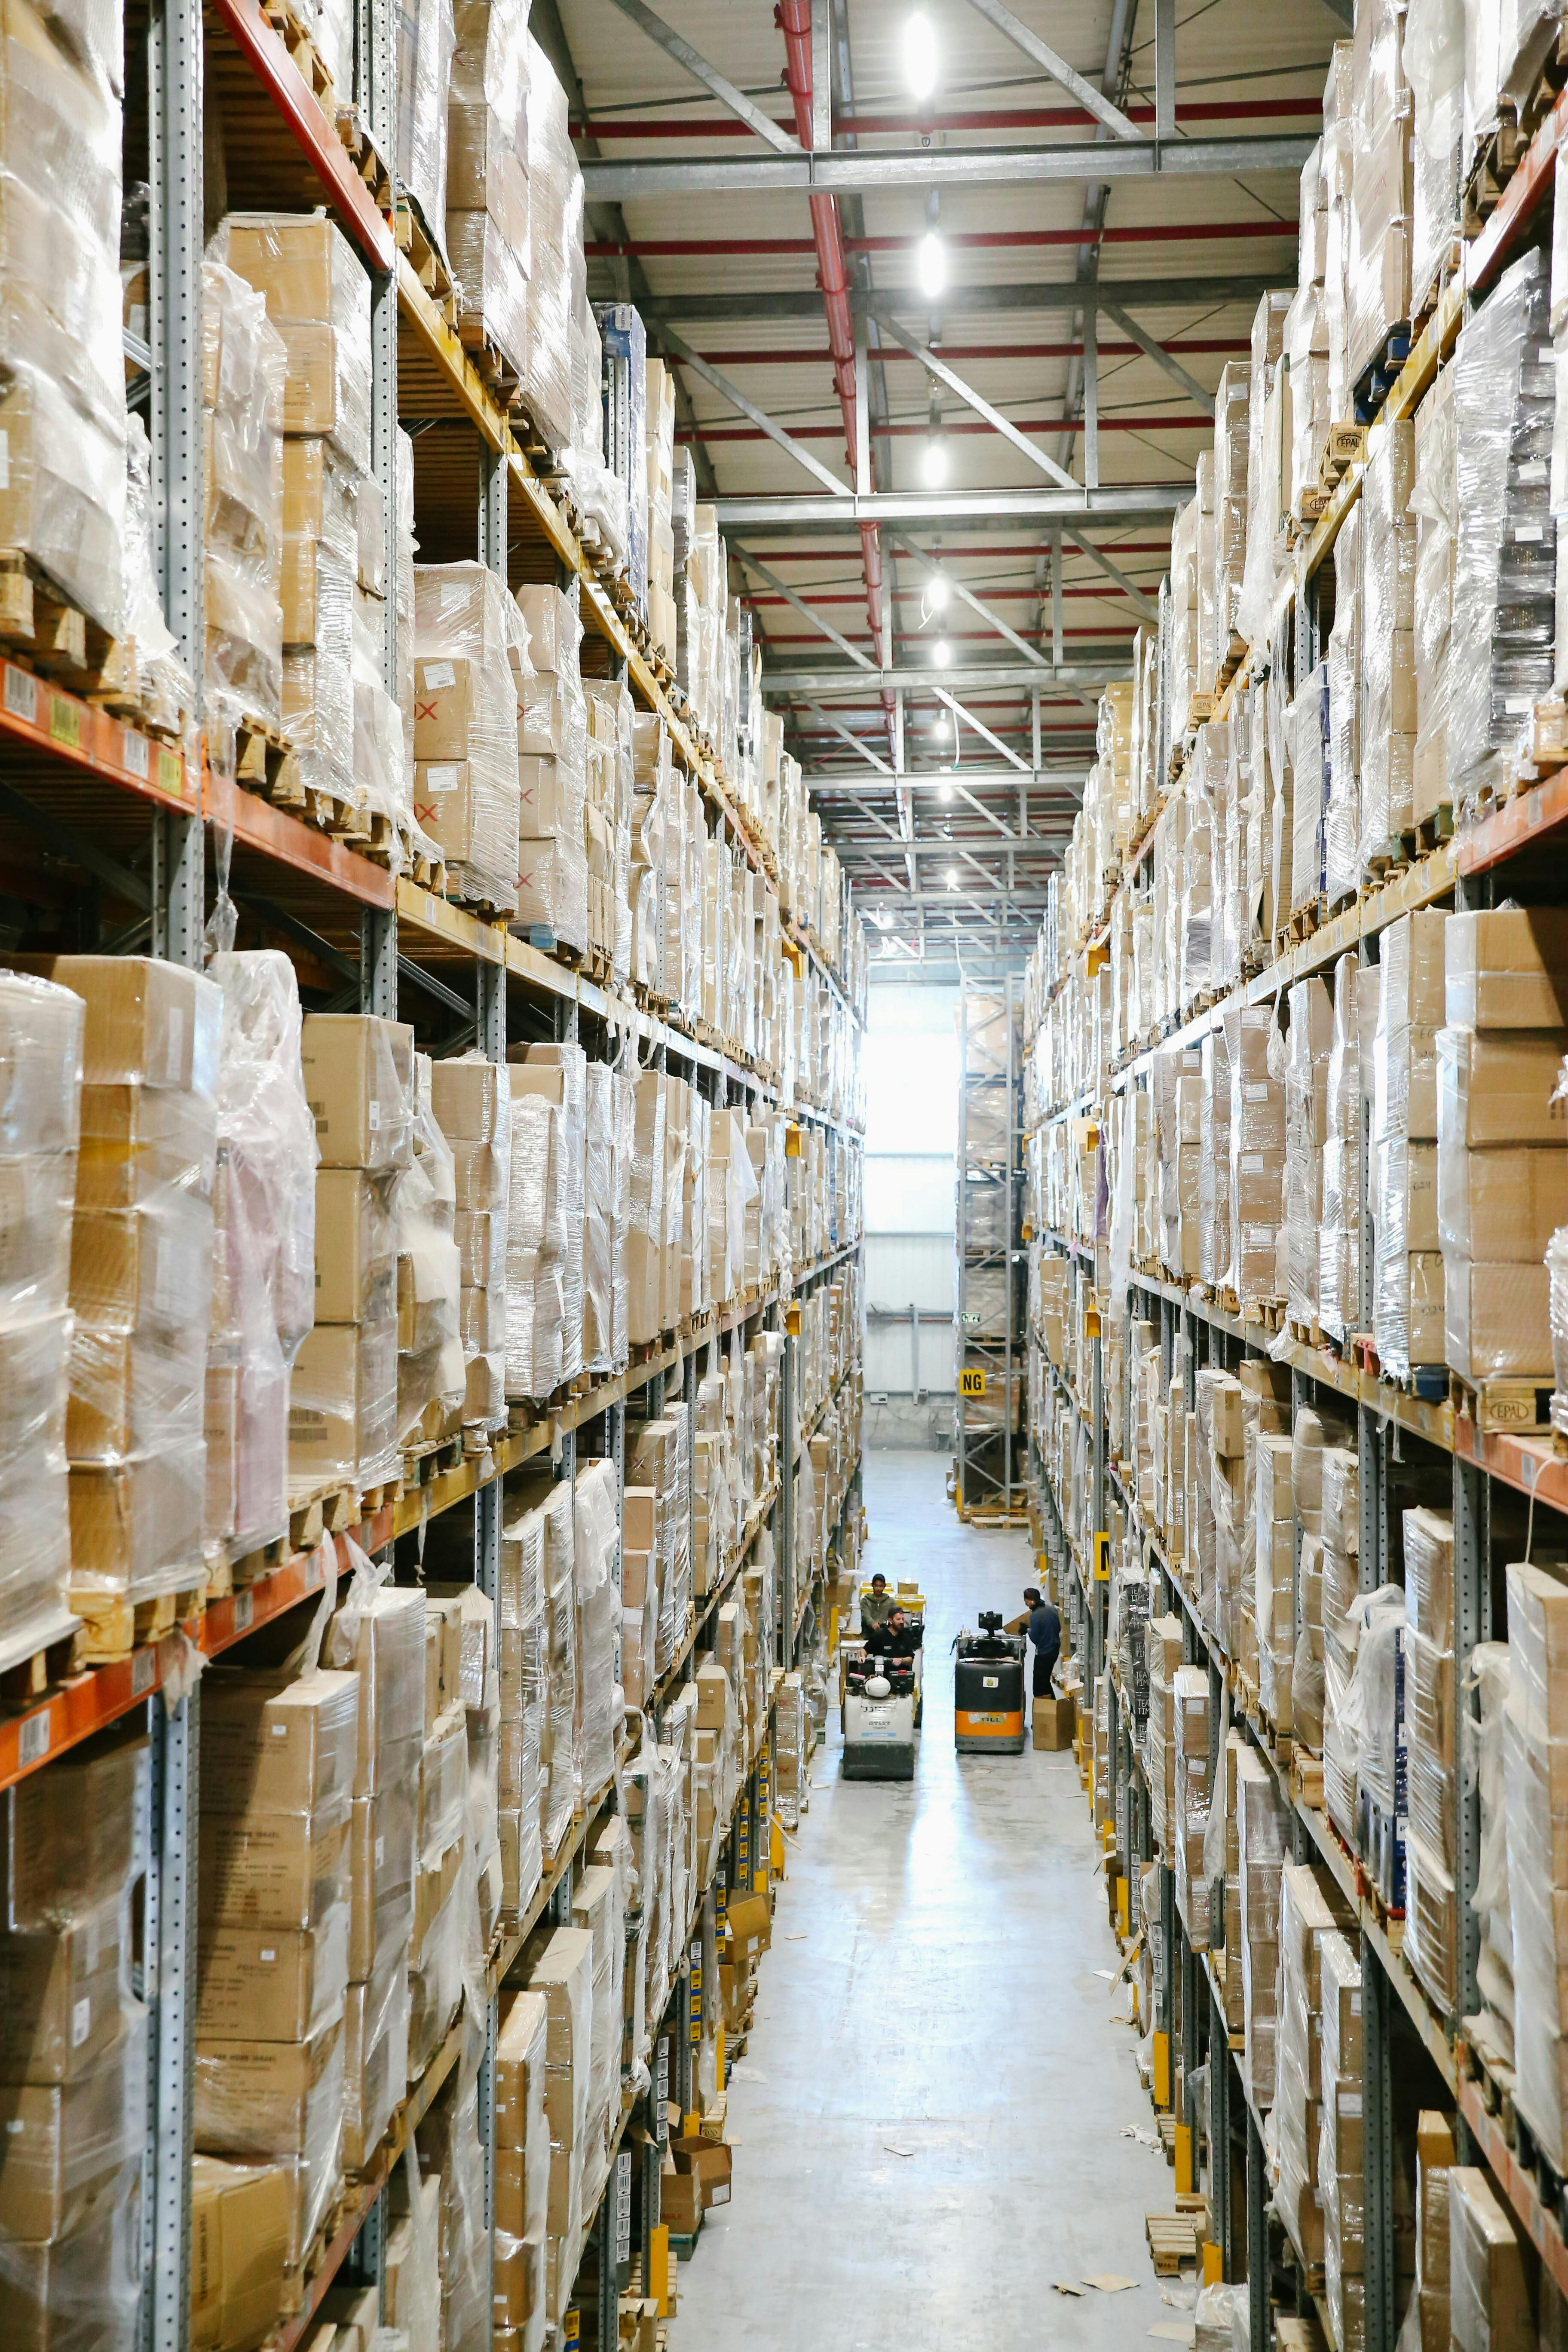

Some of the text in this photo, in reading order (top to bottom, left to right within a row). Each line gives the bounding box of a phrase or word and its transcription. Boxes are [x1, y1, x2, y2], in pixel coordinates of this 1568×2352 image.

[1341, 438, 1359, 448] EPAL
[1314, 499, 1327, 509] EPA
[414, 701, 438, 720] X
[414, 804, 438, 822] X
[963, 1374, 982, 1391] NG
[1498, 1403, 1520, 1418] EPAL
